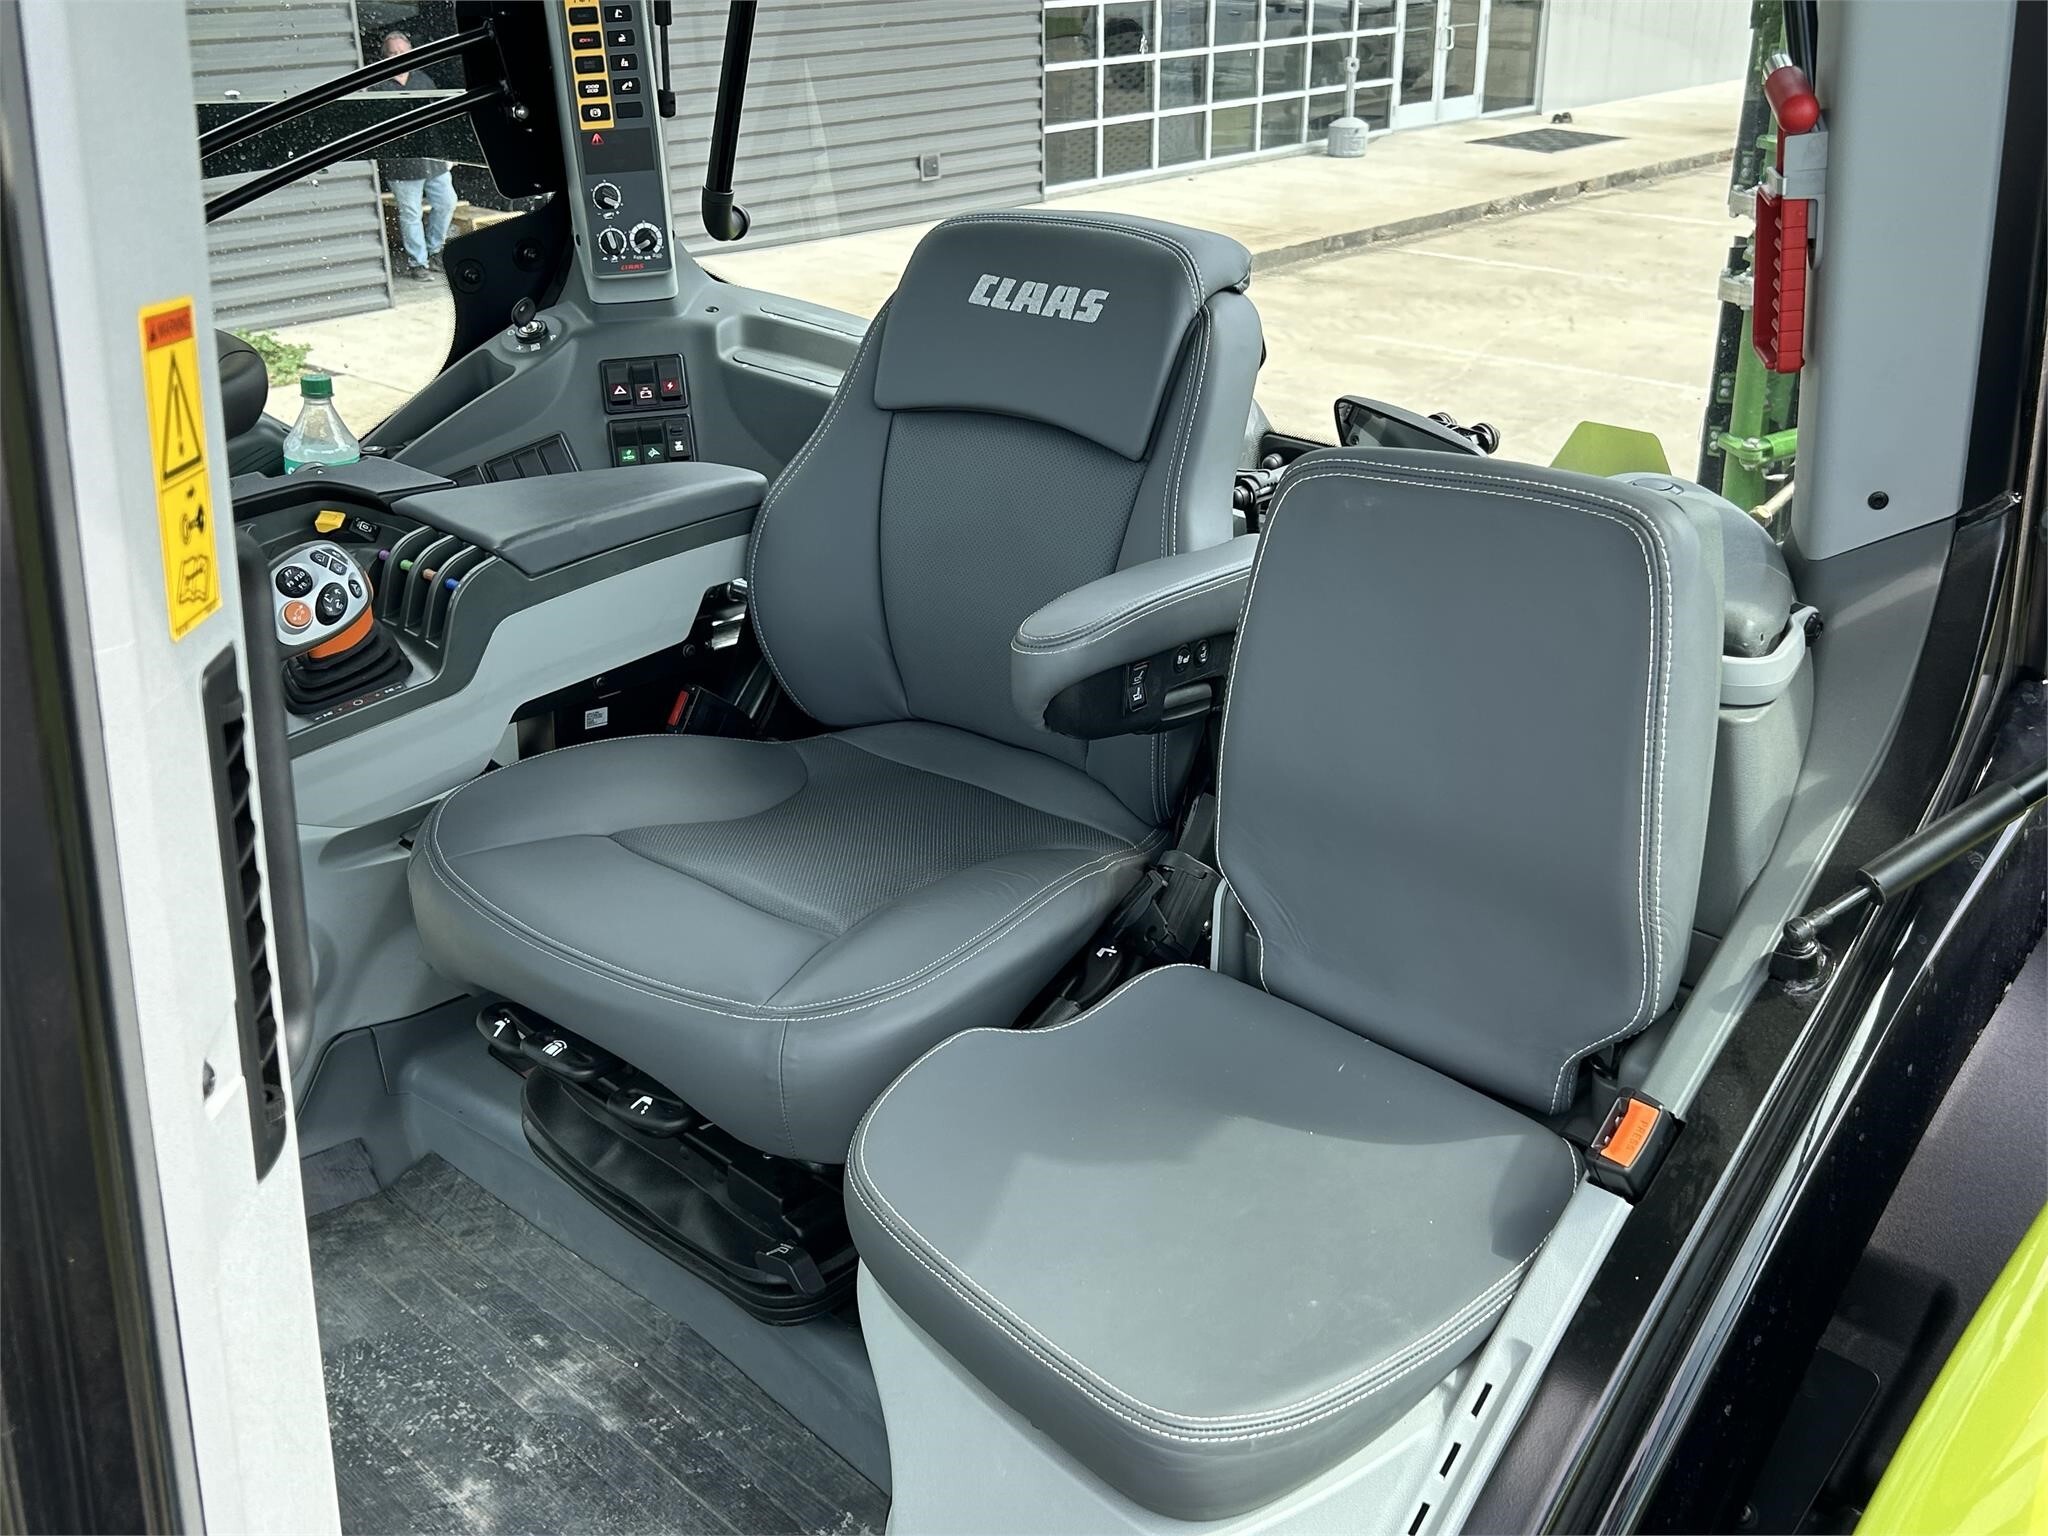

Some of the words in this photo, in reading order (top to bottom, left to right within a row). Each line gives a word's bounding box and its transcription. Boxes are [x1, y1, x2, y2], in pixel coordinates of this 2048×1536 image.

[968, 273, 1110, 323] CLAAS
[284, 569, 292, 578] F7
[294, 571, 306, 582] F10
